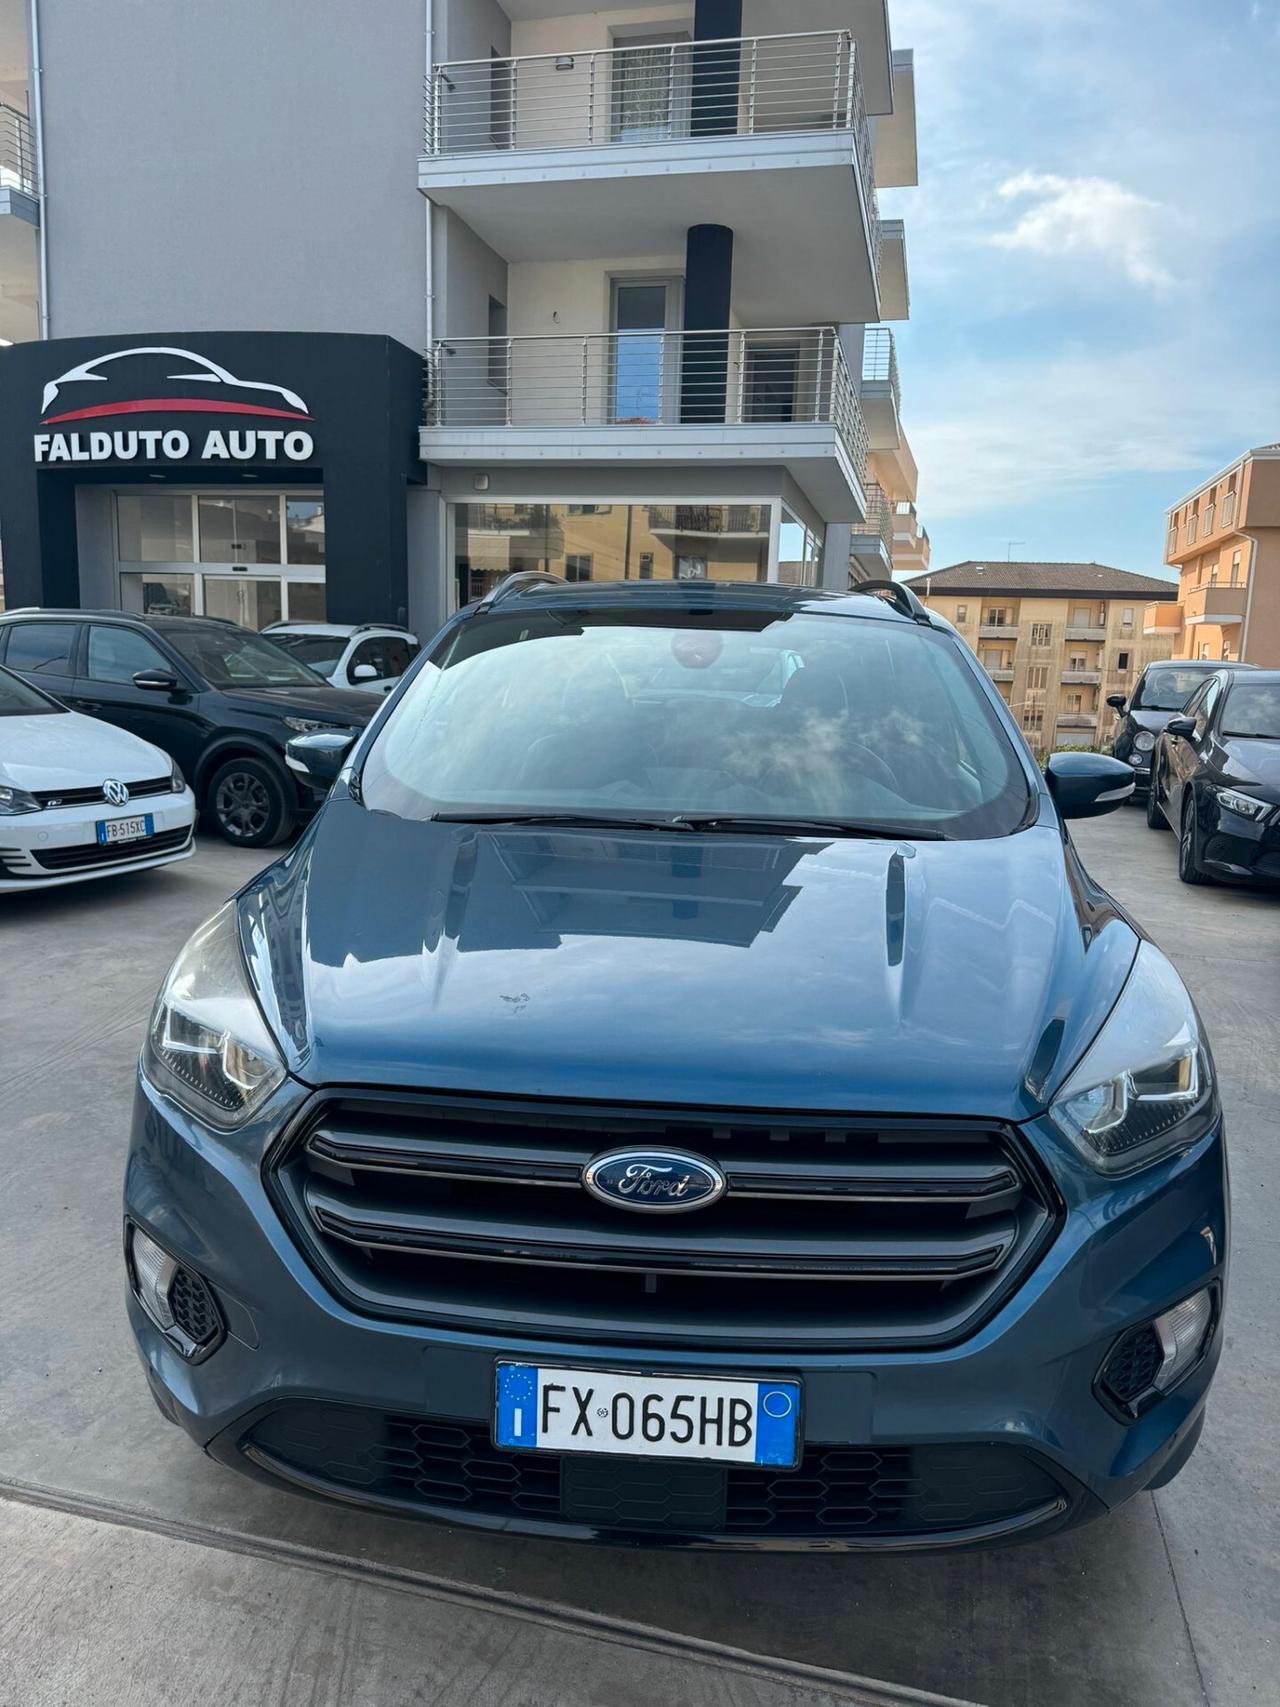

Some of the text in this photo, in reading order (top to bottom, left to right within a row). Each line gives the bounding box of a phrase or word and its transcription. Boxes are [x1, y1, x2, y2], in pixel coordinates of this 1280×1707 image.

[34, 430, 314, 462] FALDUTO AUTO
[617, 1163, 690, 1197] Ford
